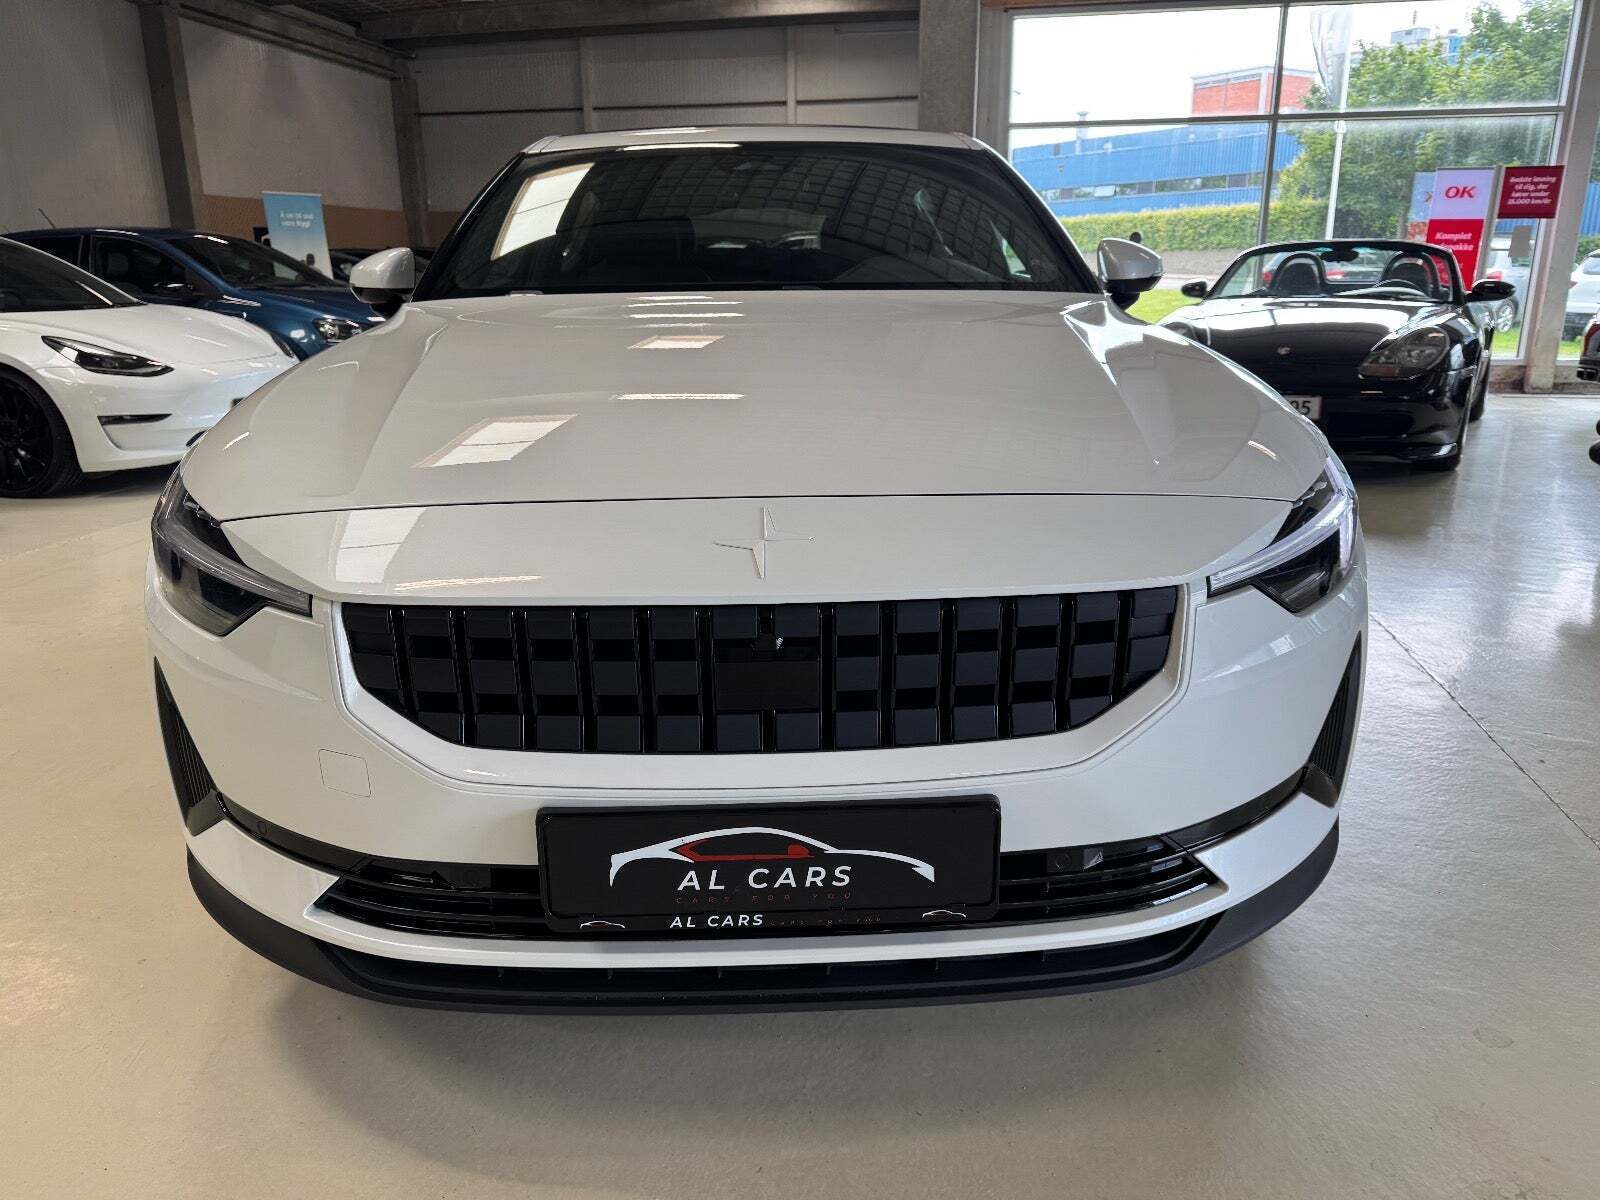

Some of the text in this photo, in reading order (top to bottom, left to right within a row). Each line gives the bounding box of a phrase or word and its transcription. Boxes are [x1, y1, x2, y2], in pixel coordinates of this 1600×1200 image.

[1445, 186, 1476, 199] OK
[1434, 232, 1473, 241] Komplet
[677, 865, 853, 891] AL CARS
[669, 917, 696, 928] AL
[706, 914, 764, 928] CARS
